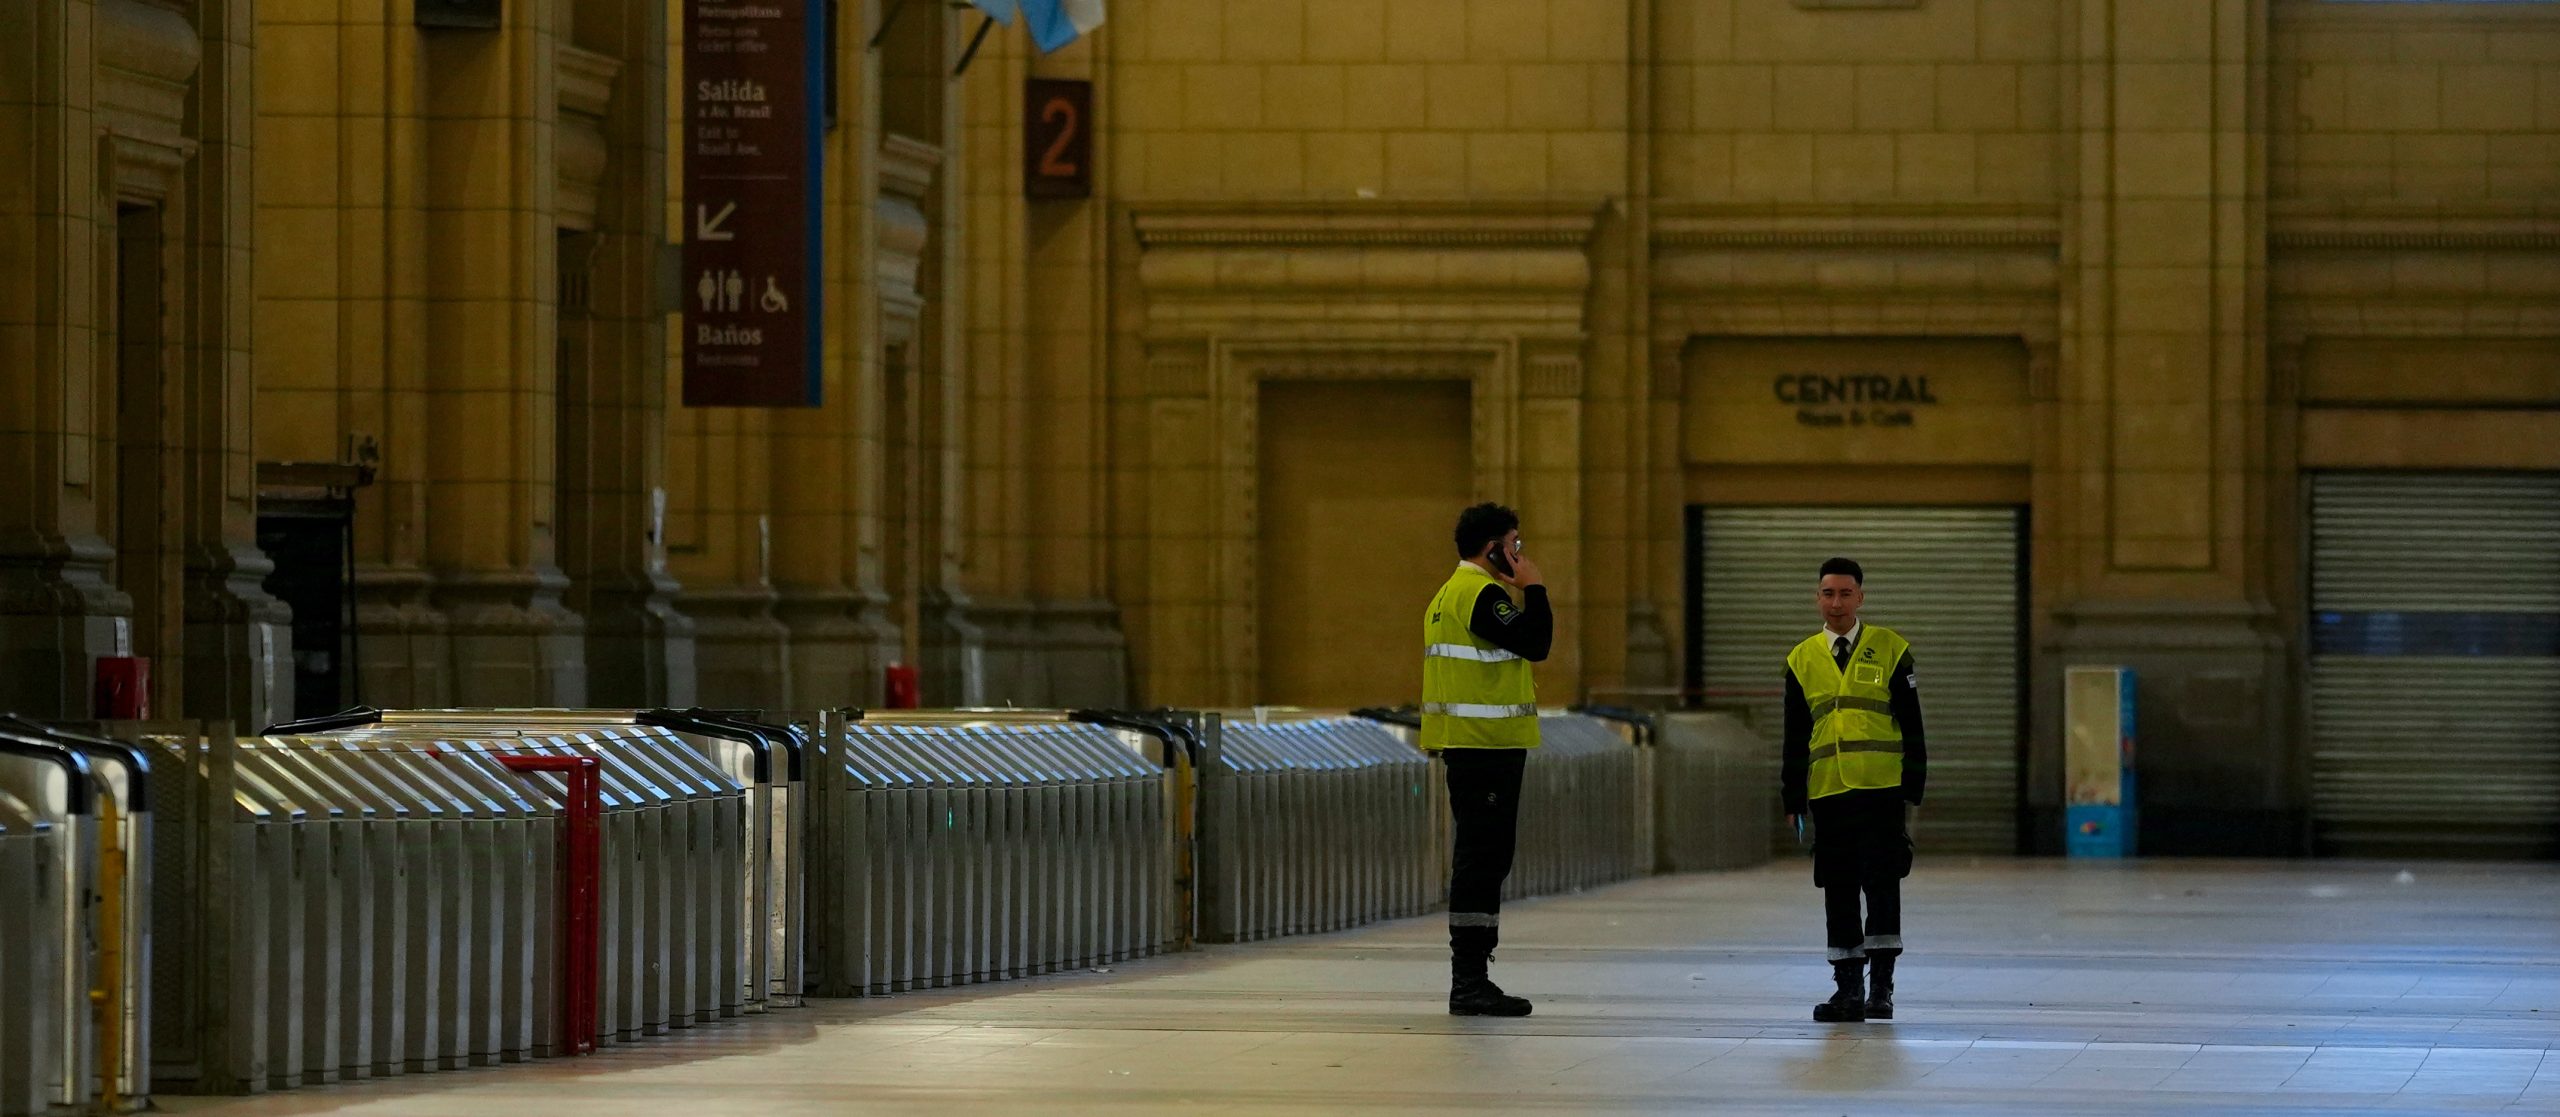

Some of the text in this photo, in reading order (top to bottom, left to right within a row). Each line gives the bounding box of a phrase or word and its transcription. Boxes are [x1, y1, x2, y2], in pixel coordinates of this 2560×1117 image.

[698, 79, 765, 101] Salida
[734, 105, 771, 118] Brasil
[1042, 96, 1077, 176] 2
[697, 323, 762, 345] Baños
[1775, 374, 1937, 403] CENTRAL
